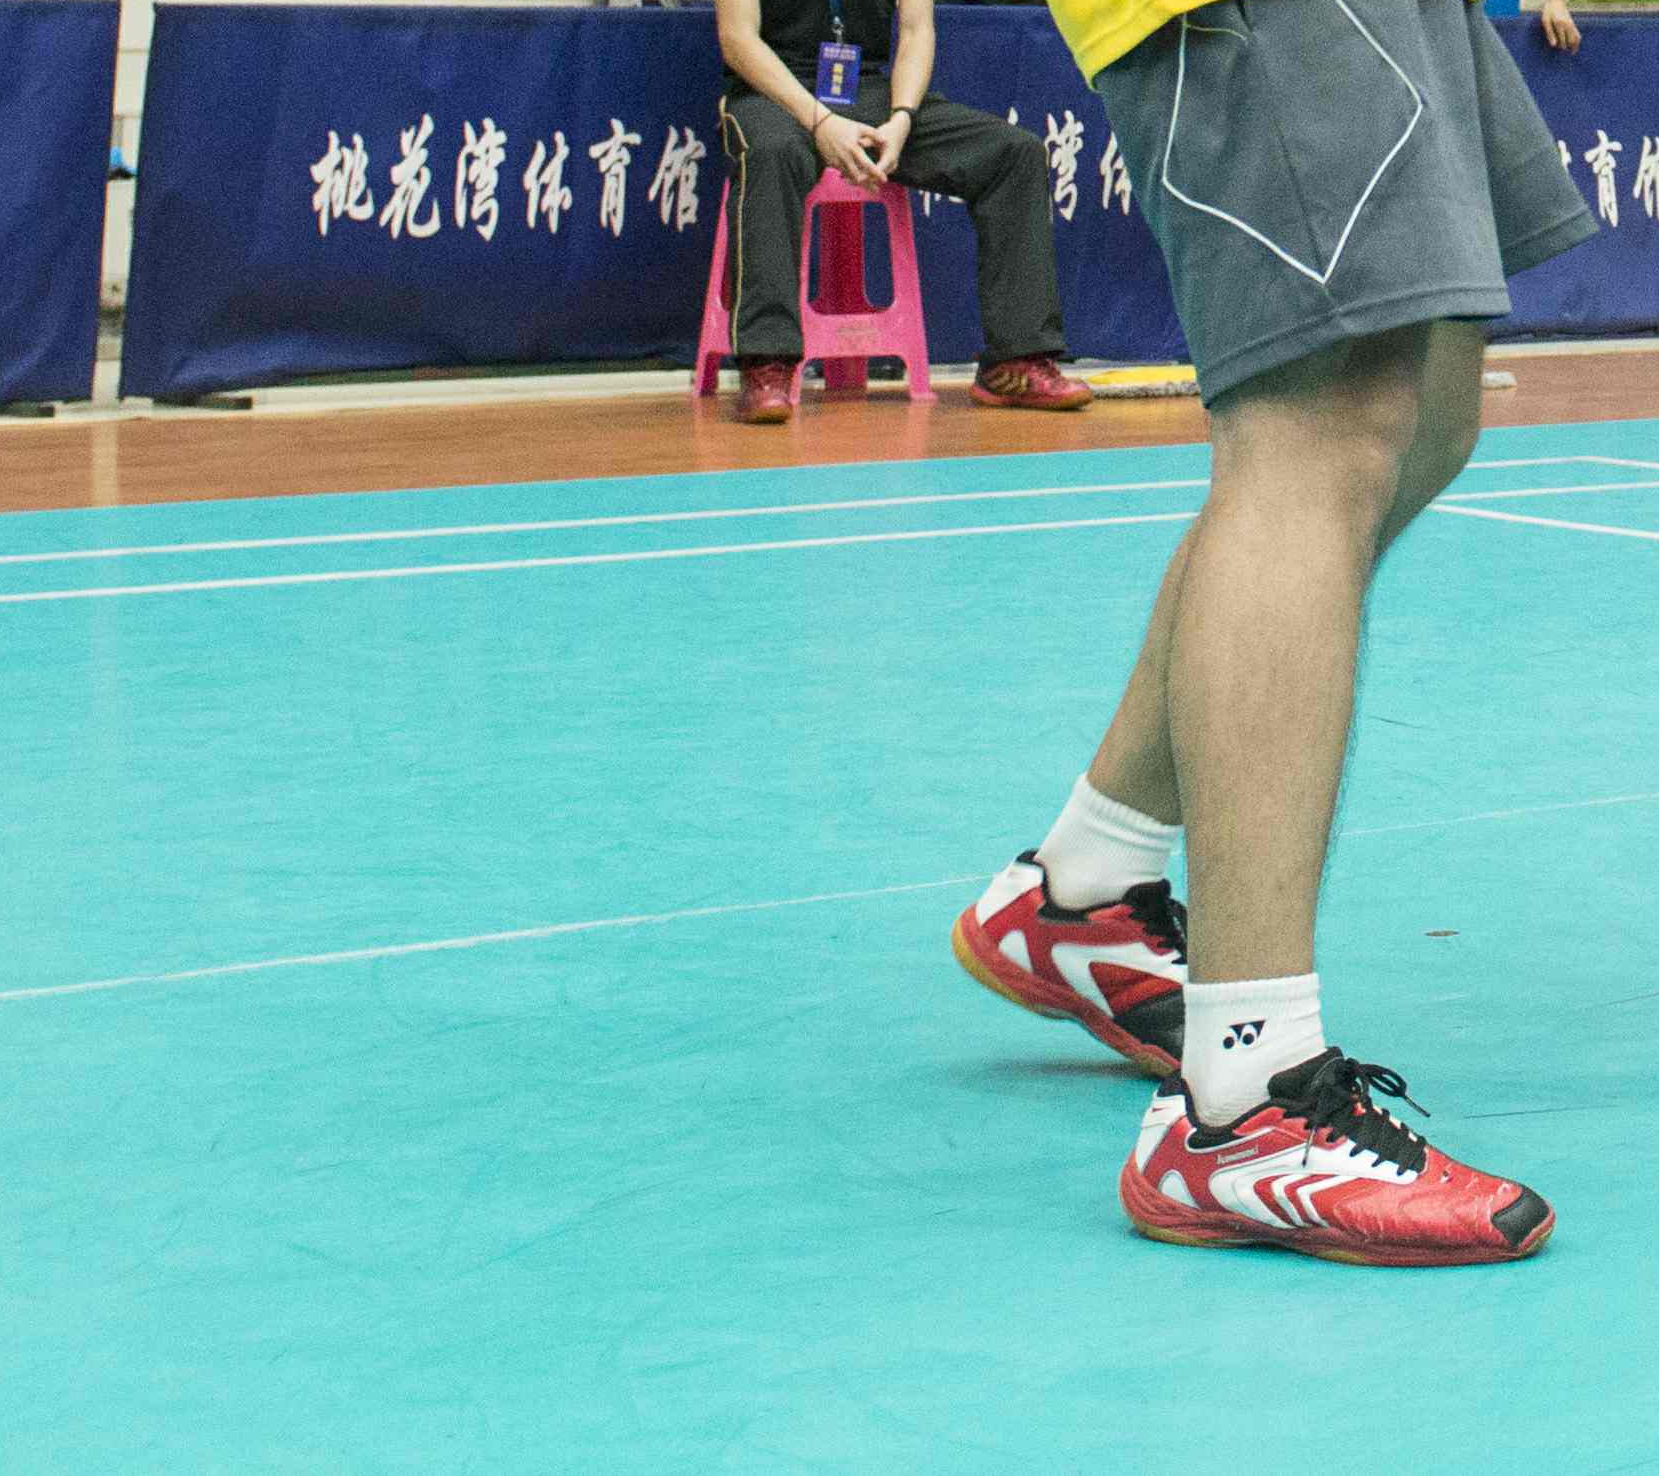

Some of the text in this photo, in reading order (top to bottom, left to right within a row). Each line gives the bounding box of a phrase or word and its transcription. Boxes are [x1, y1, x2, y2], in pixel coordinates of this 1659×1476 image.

[310, 112, 707, 242] 桃花湾体育馆
